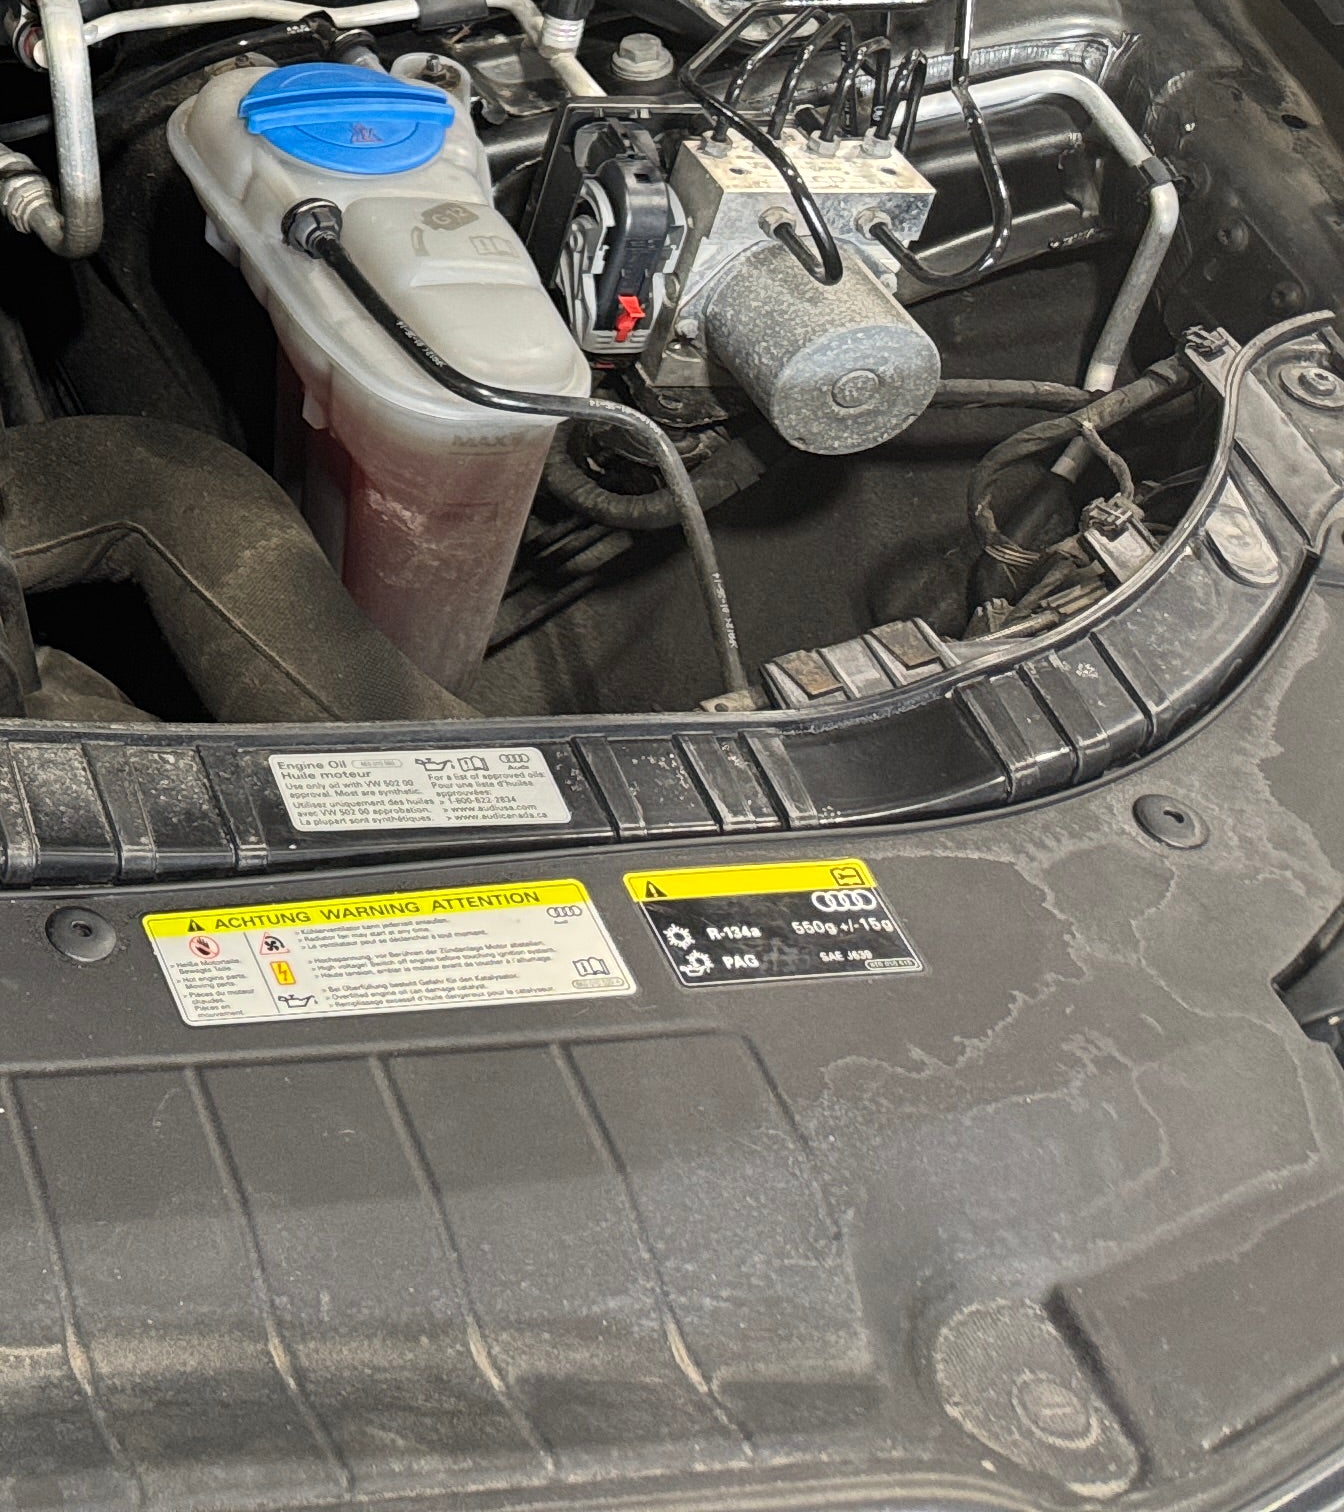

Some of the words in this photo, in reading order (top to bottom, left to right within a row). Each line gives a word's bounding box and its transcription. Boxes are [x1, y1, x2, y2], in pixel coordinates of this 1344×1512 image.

[278, 761, 325, 772] Engine
[281, 772, 316, 780] Huile
[320, 770, 373, 779] moteur
[482, 772, 526, 780] approved
[305, 782, 326, 790] only
[329, 800, 386, 808] uniquement
[313, 818, 348, 826] plupart
[215, 912, 312, 930] ACHTUNG
[321, 902, 420, 920] WARNING
[431, 892, 541, 911] ATTENTION
[705, 925, 763, 940] R-134a
[791, 920, 839, 937] 550g
[819, 952, 845, 962] SAE
[845, 949, 874, 960] J639
[722, 955, 761, 969] PAG
